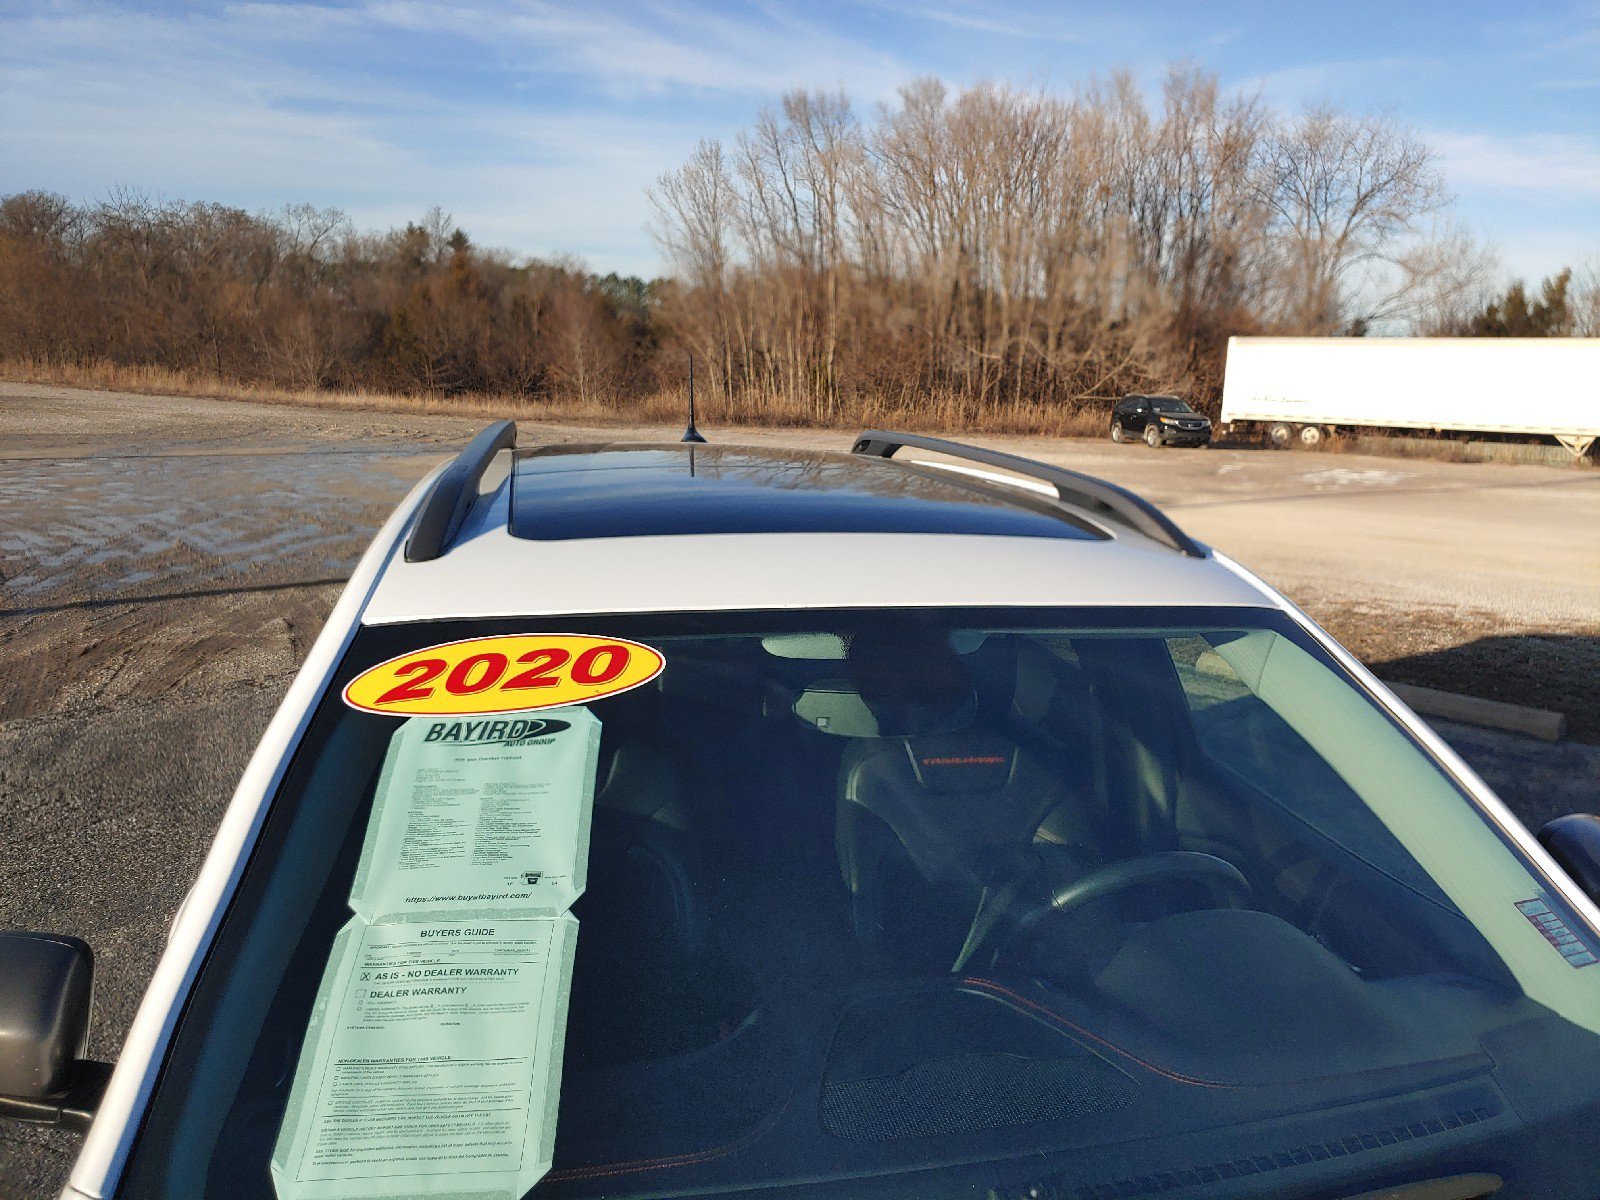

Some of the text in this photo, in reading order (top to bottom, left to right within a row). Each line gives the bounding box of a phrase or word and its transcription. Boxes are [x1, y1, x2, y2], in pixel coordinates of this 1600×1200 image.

[374, 645, 632, 706] 2020
[423, 719, 530, 742] BAYIRD
[504, 738, 556, 748] AUTO GROUP
[420, 928, 496, 938] BUYERS GUIDE
[374, 972, 389, 981] AS
[390, 971, 400, 979] IS
[407, 970, 422, 978] NO
[423, 968, 463, 978] DEALER
[465, 968, 520, 976] WARRANTY
[369, 986, 468, 999] DEALER WARRANTY
